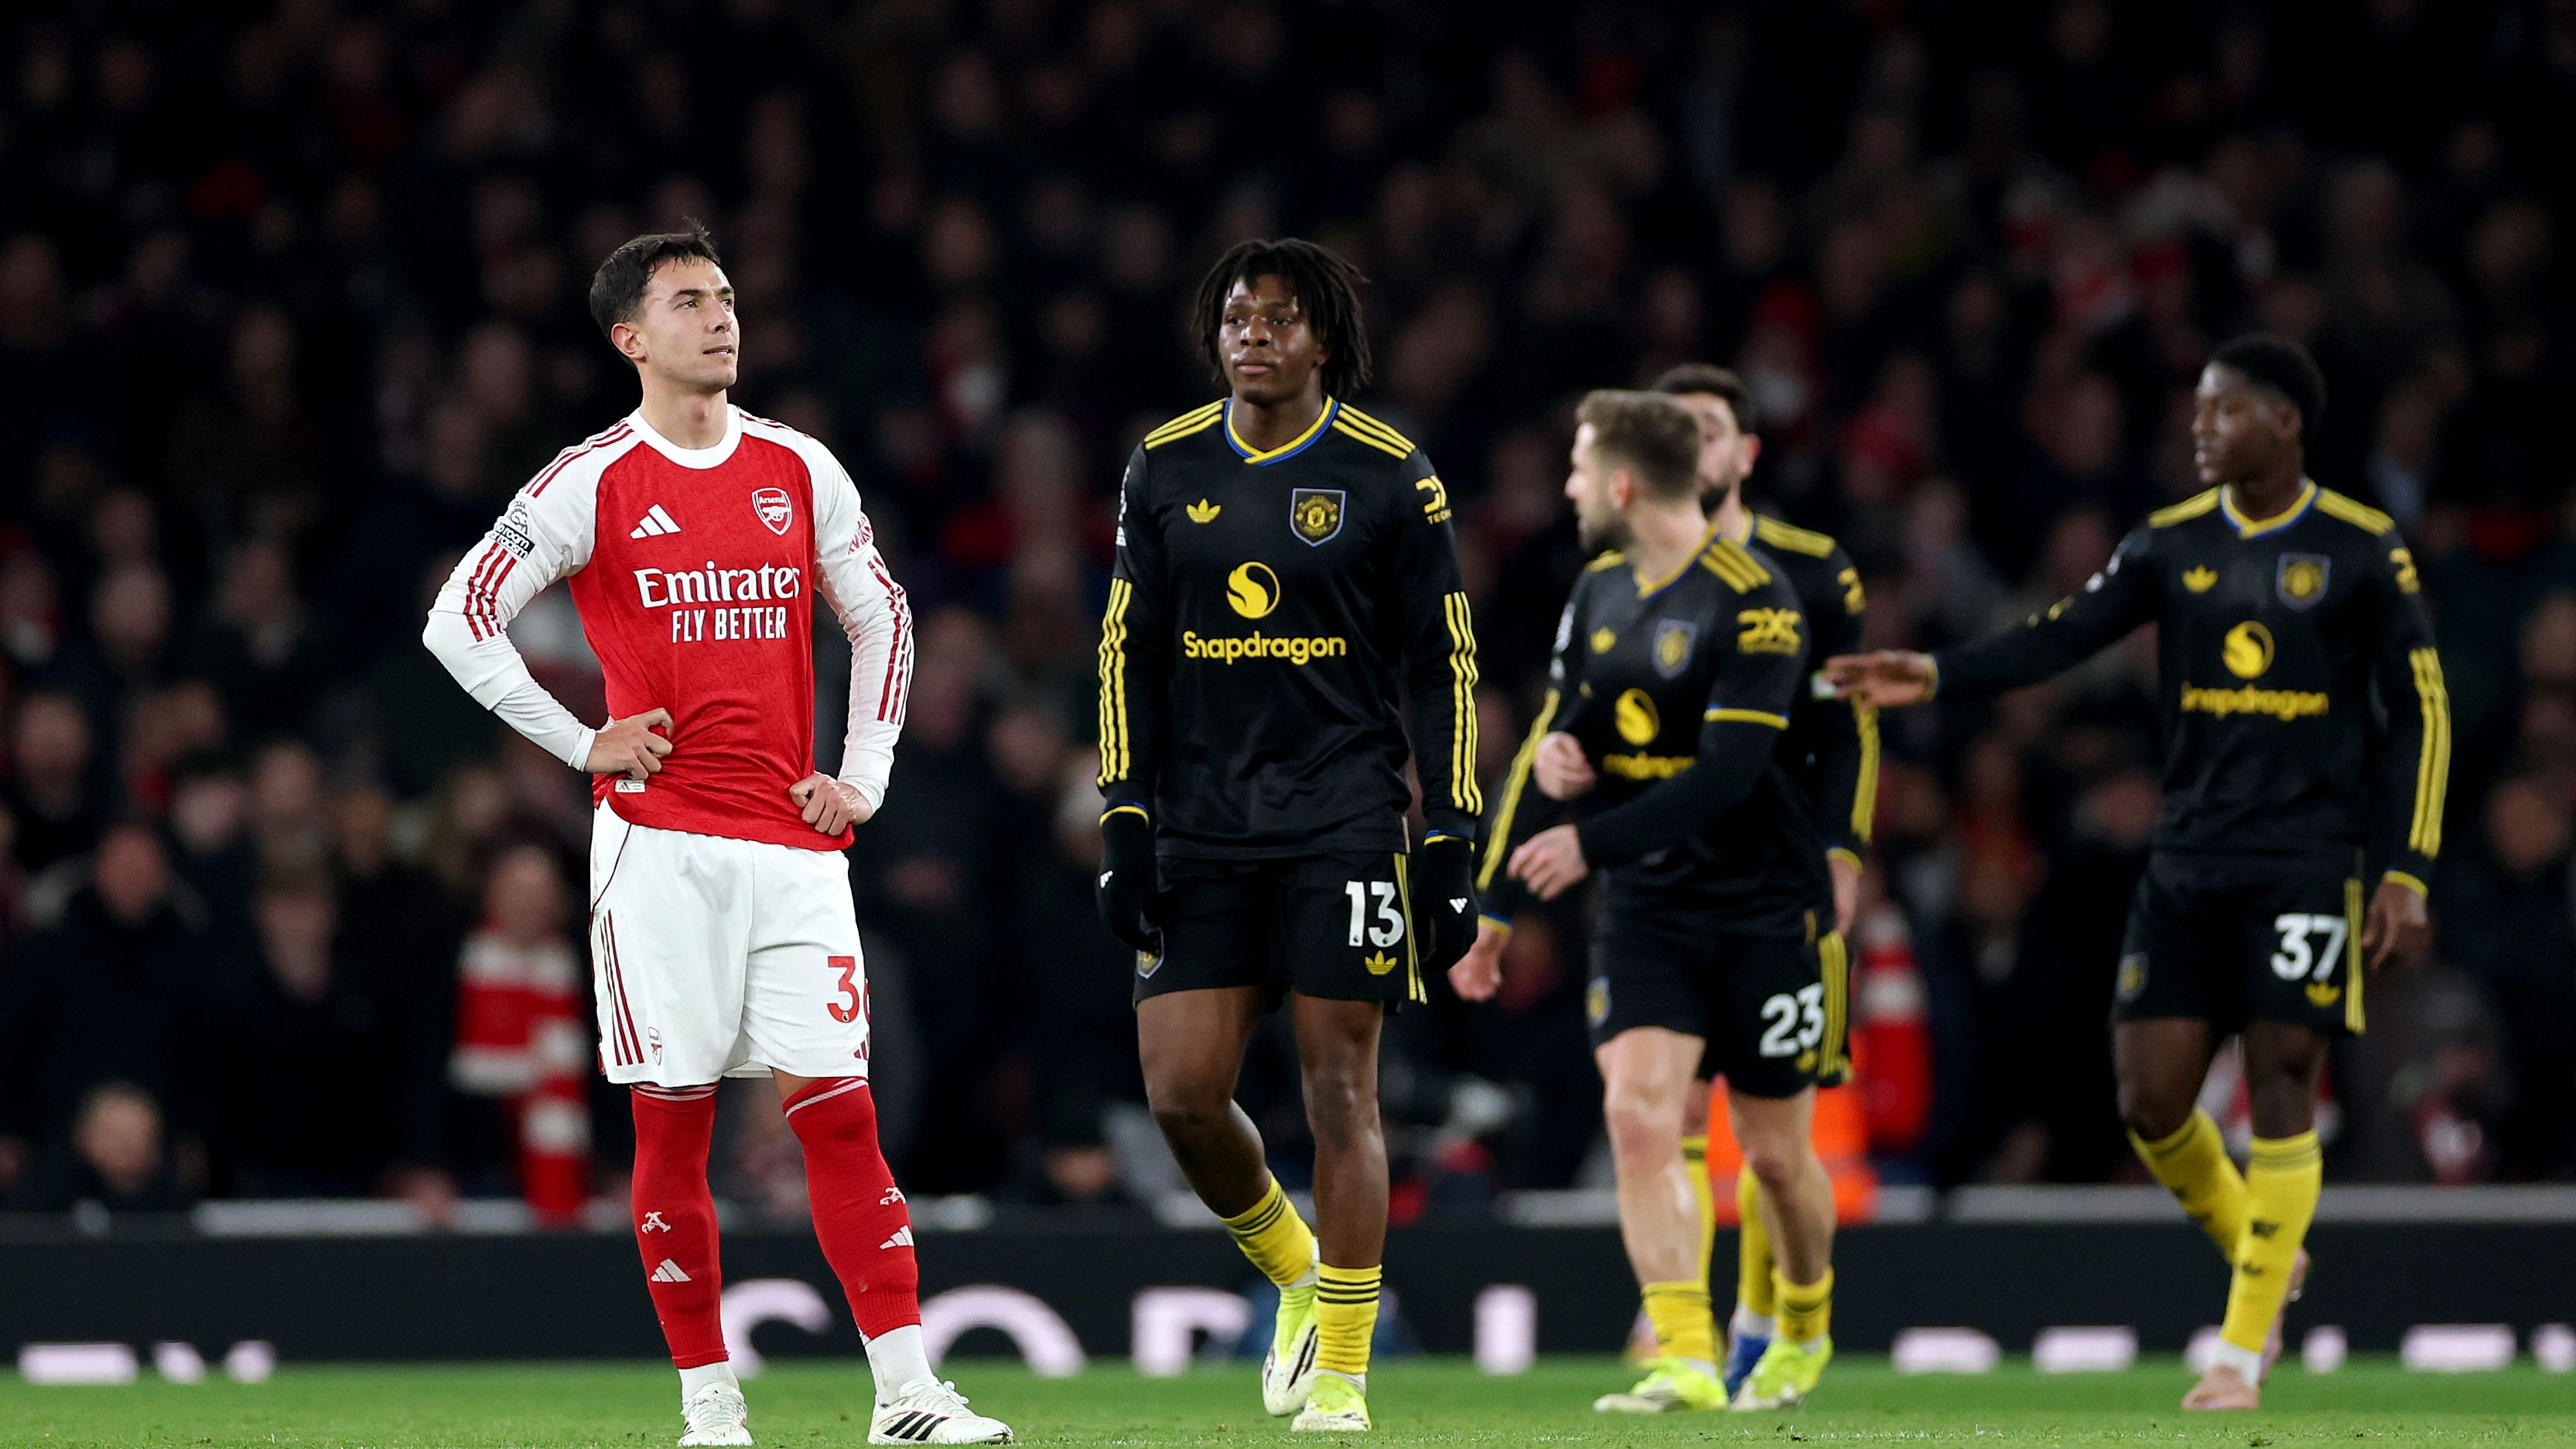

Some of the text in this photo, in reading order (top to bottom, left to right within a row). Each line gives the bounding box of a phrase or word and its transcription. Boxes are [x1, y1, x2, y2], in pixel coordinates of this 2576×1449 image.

[503, 526, 530, 549] room
[633, 561, 799, 608] Emirates
[671, 605, 787, 643] FLY BETTER
[1183, 631, 1347, 666] Snapdragon
[1344, 880, 1405, 948] 13
[2270, 913, 2349, 982] 37
[826, 956, 871, 1026] 3
[1759, 982, 1825, 1058] 23
